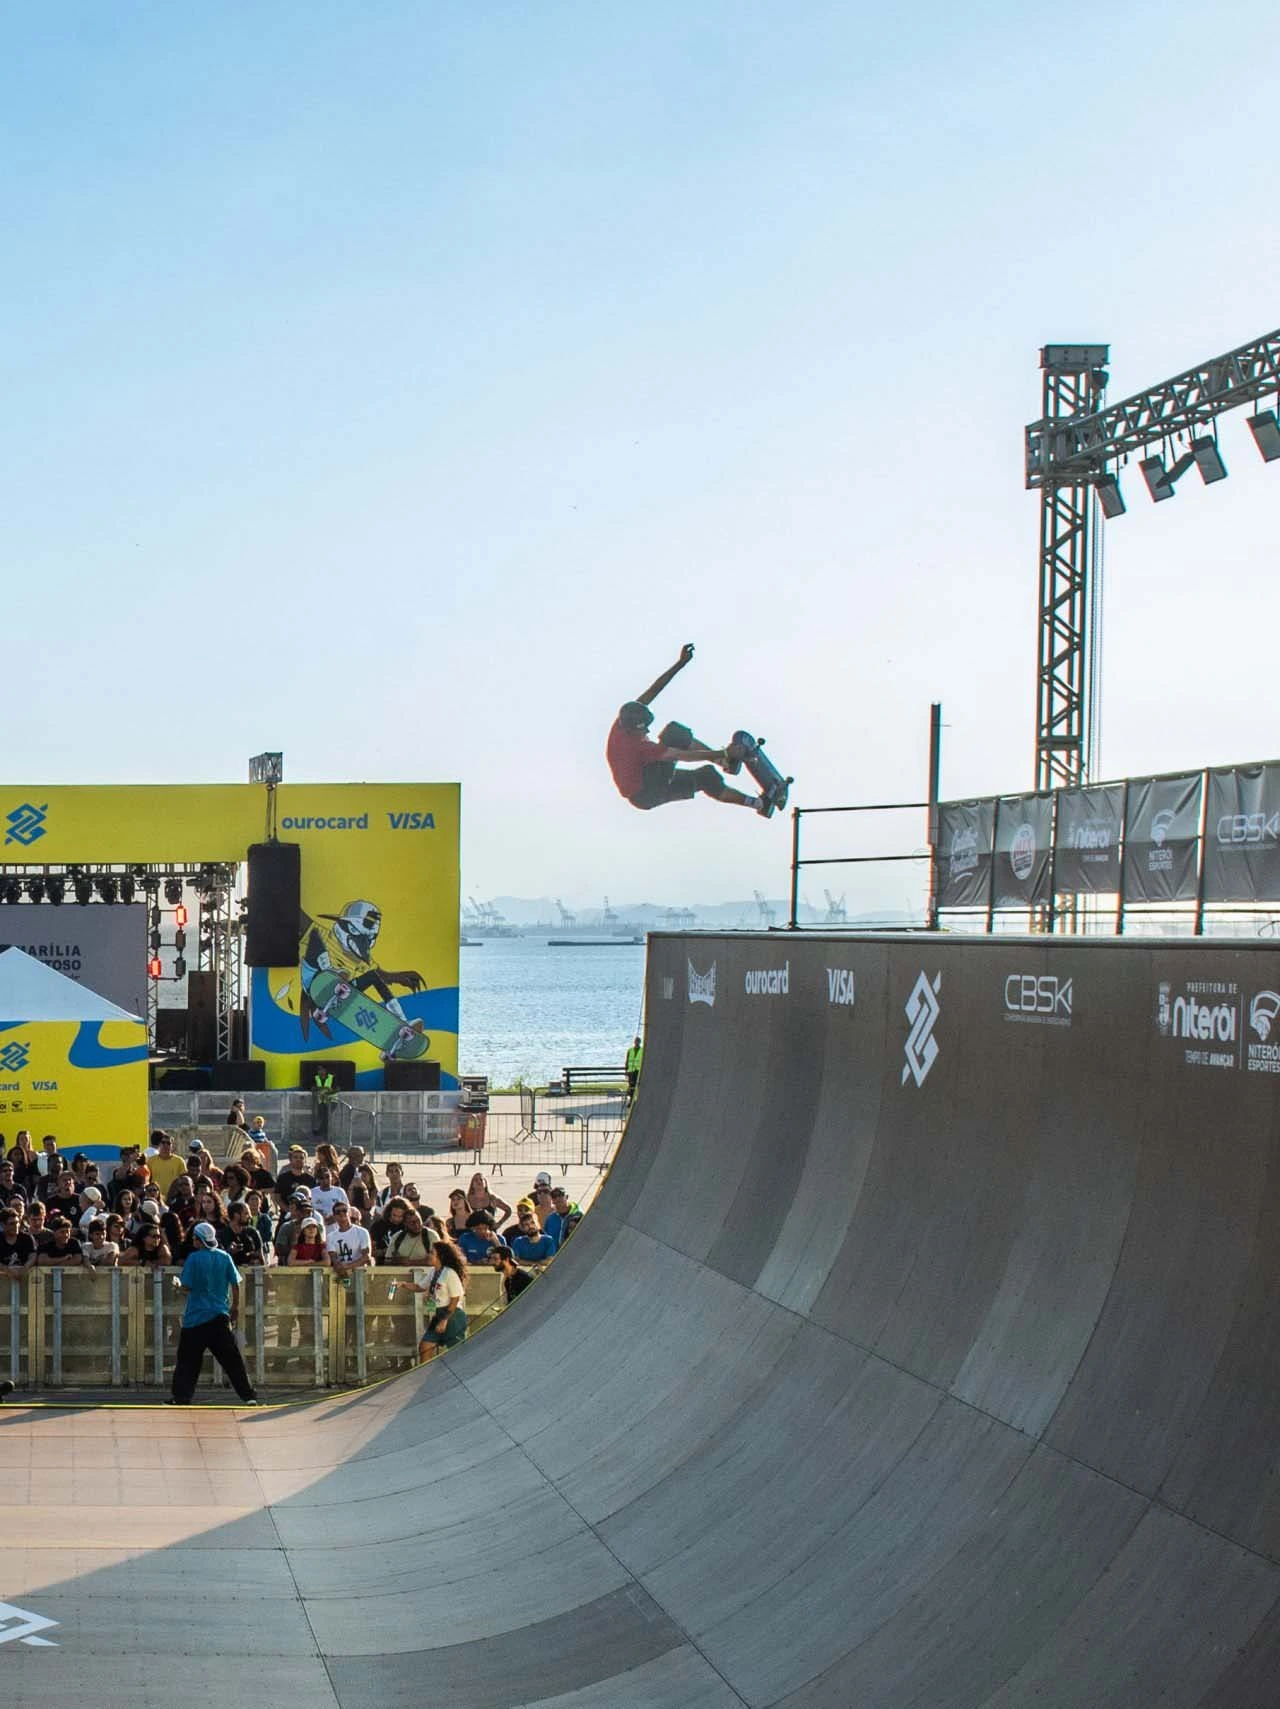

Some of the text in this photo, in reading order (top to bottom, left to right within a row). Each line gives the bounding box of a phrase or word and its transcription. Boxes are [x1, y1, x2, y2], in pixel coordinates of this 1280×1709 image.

[281, 812, 368, 829] ourocard
[386, 812, 435, 829] VISA
[745, 959, 790, 994] ourocard
[826, 967, 855, 1006] VISA
[32, 1080, 58, 1091] VISA
